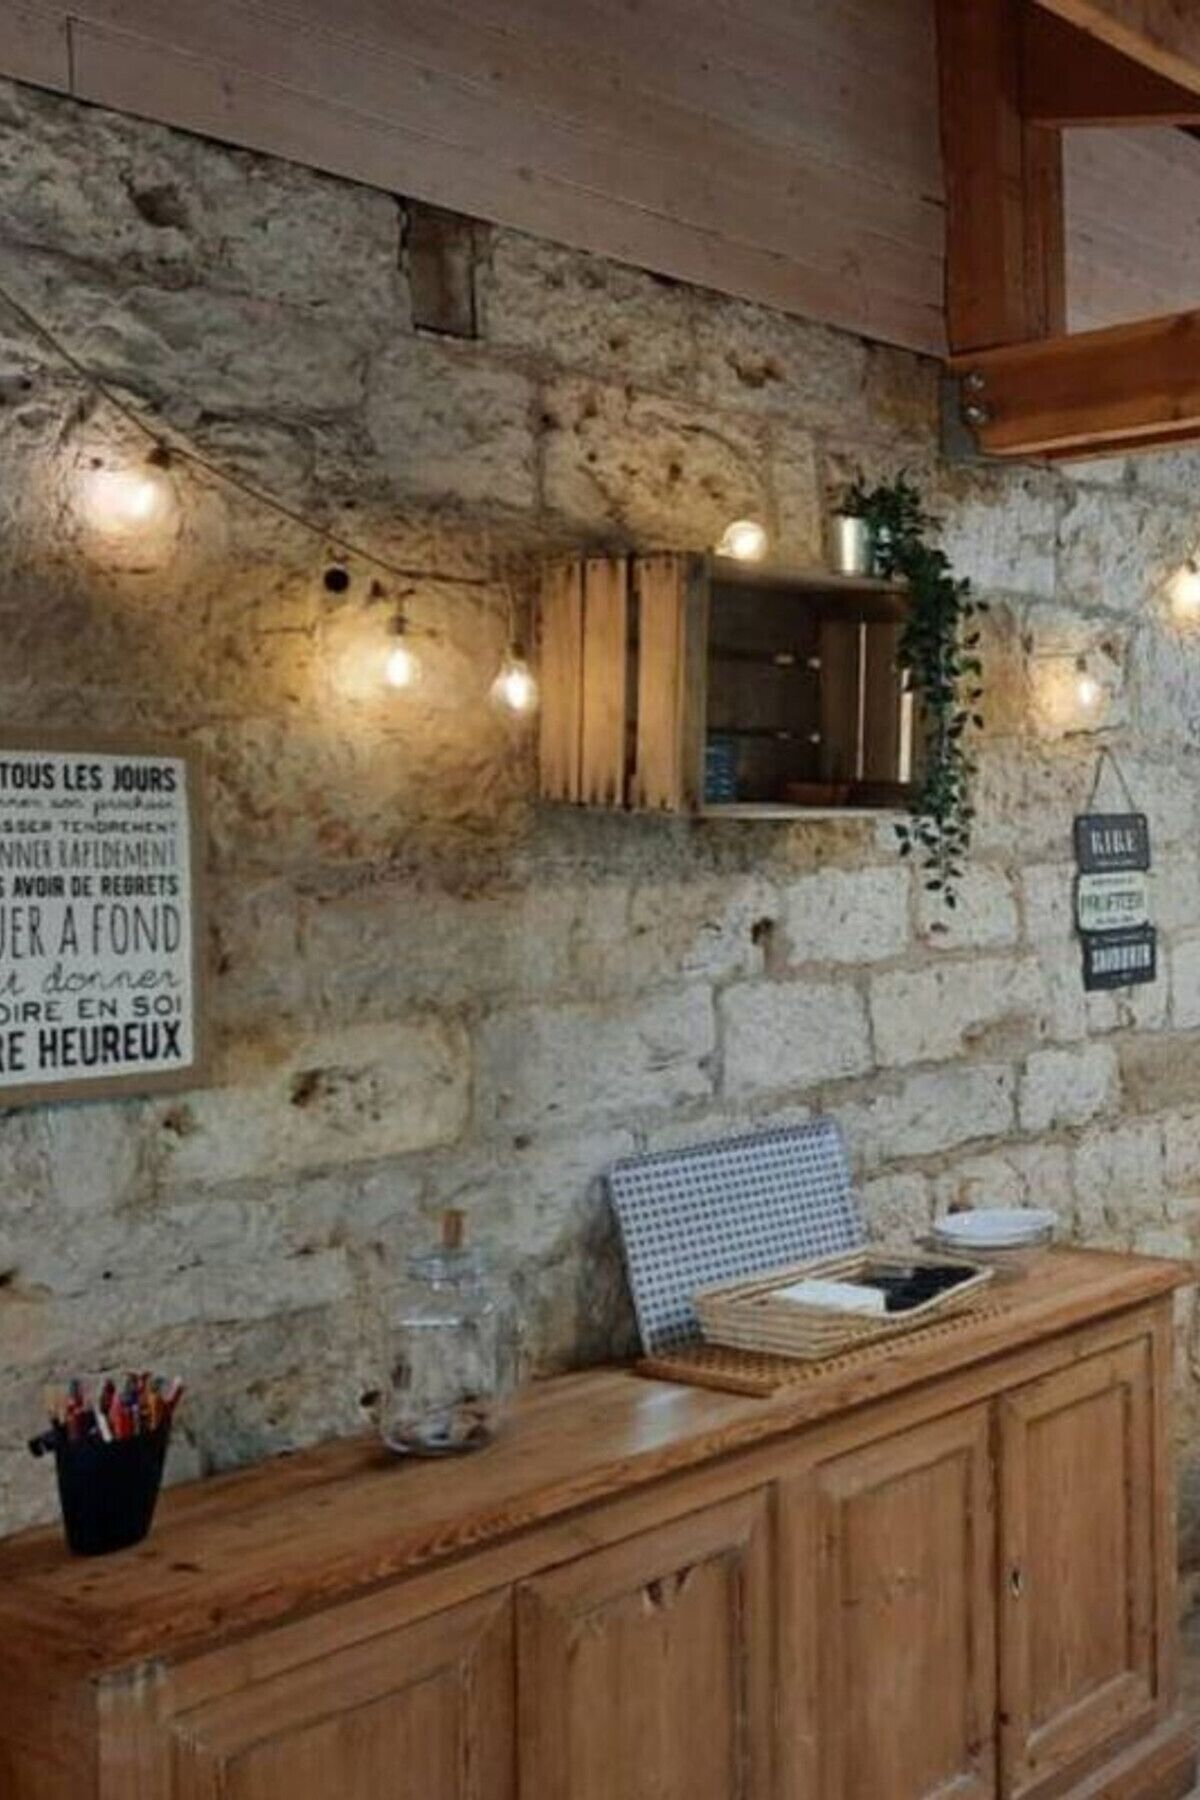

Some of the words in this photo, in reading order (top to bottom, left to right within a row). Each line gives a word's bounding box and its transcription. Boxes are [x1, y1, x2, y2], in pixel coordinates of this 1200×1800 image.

[0, 763, 55, 789] TOUS
[63, 763, 103, 791] LES
[112, 765, 177, 792] JOURS
[13, 875, 65, 898] AVOIR
[71, 875, 92, 898] DE
[101, 874, 178, 897] REGRETS
[93, 903, 180, 955] FOND
[43, 961, 181, 994] donner
[77, 998, 117, 1020] EN
[133, 994, 182, 1017] SOI
[38, 1019, 182, 1070] HEUREUX
